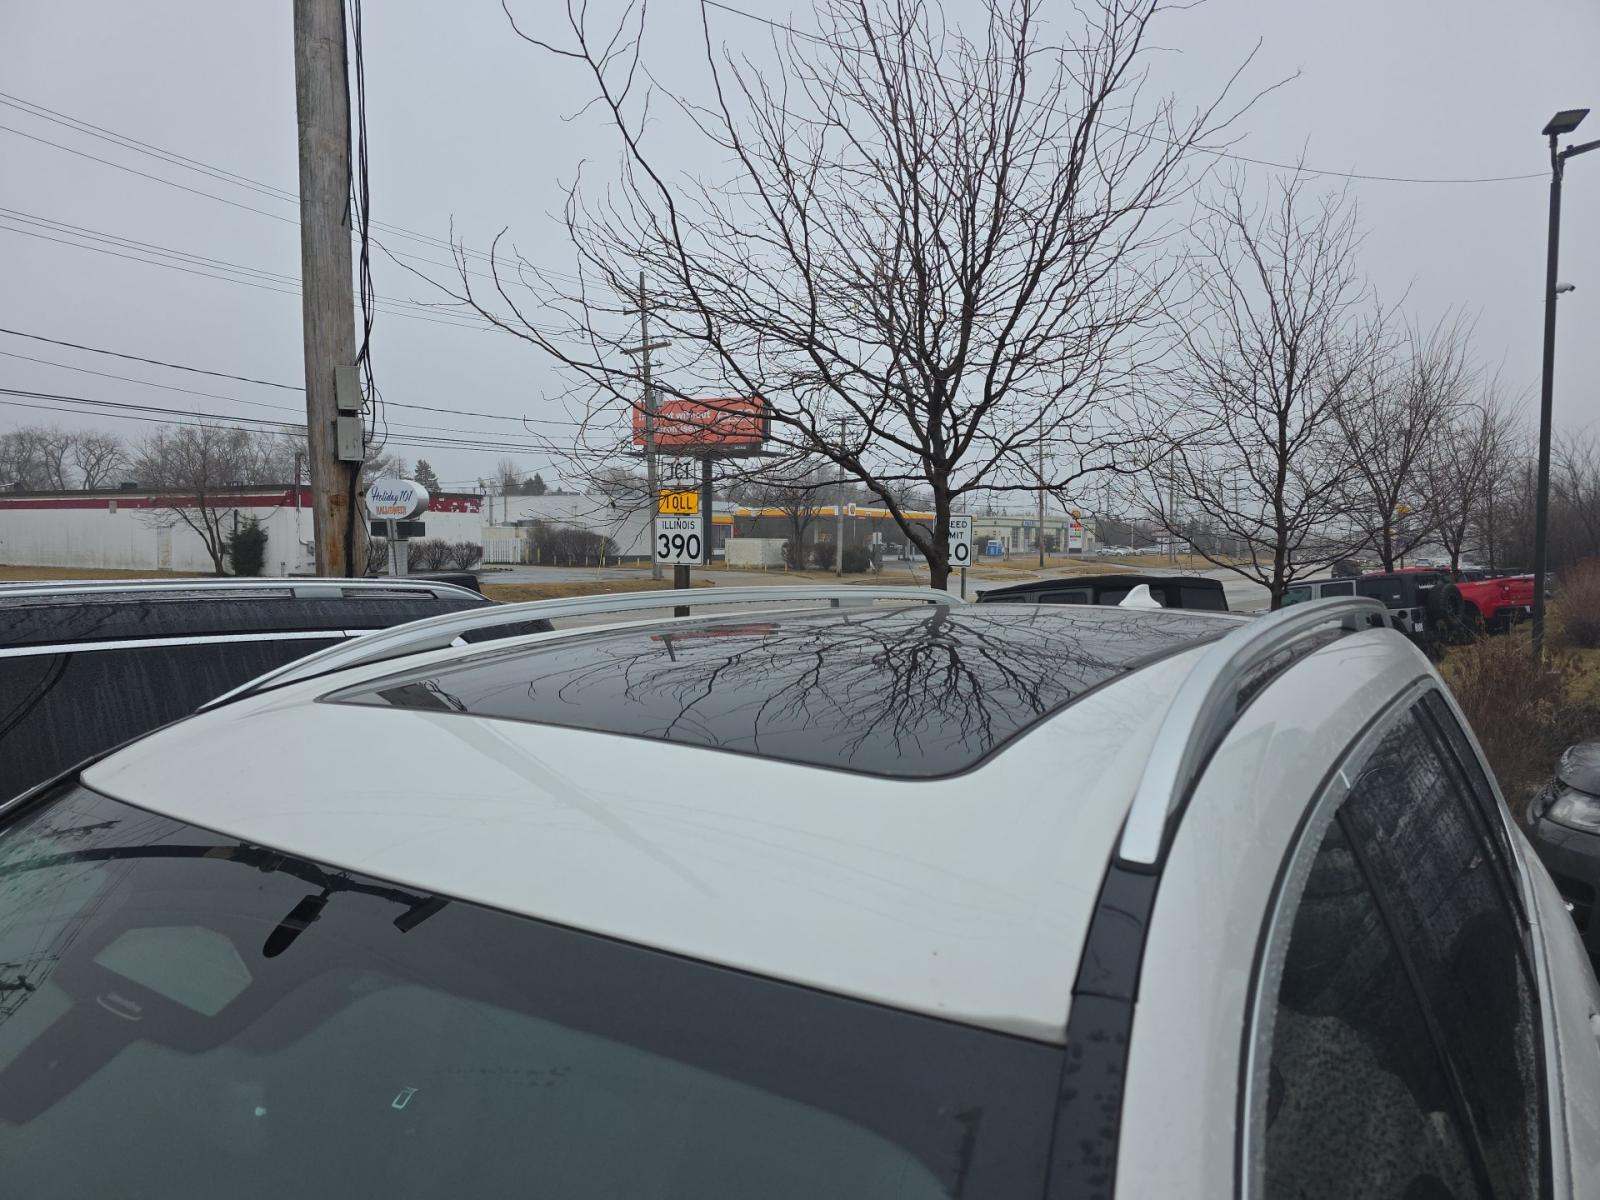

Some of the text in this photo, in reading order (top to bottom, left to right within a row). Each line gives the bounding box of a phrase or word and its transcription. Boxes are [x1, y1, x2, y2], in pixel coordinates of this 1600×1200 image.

[669, 462, 691, 480] JCT
[371, 486, 399, 505] Holiday
[664, 496, 693, 510] TOLL
[662, 520, 695, 530] ILLINOIS
[949, 520, 968, 529] EED
[949, 531, 965, 540] MIT
[657, 533, 701, 560] 390
[948, 542, 969, 561] 0
